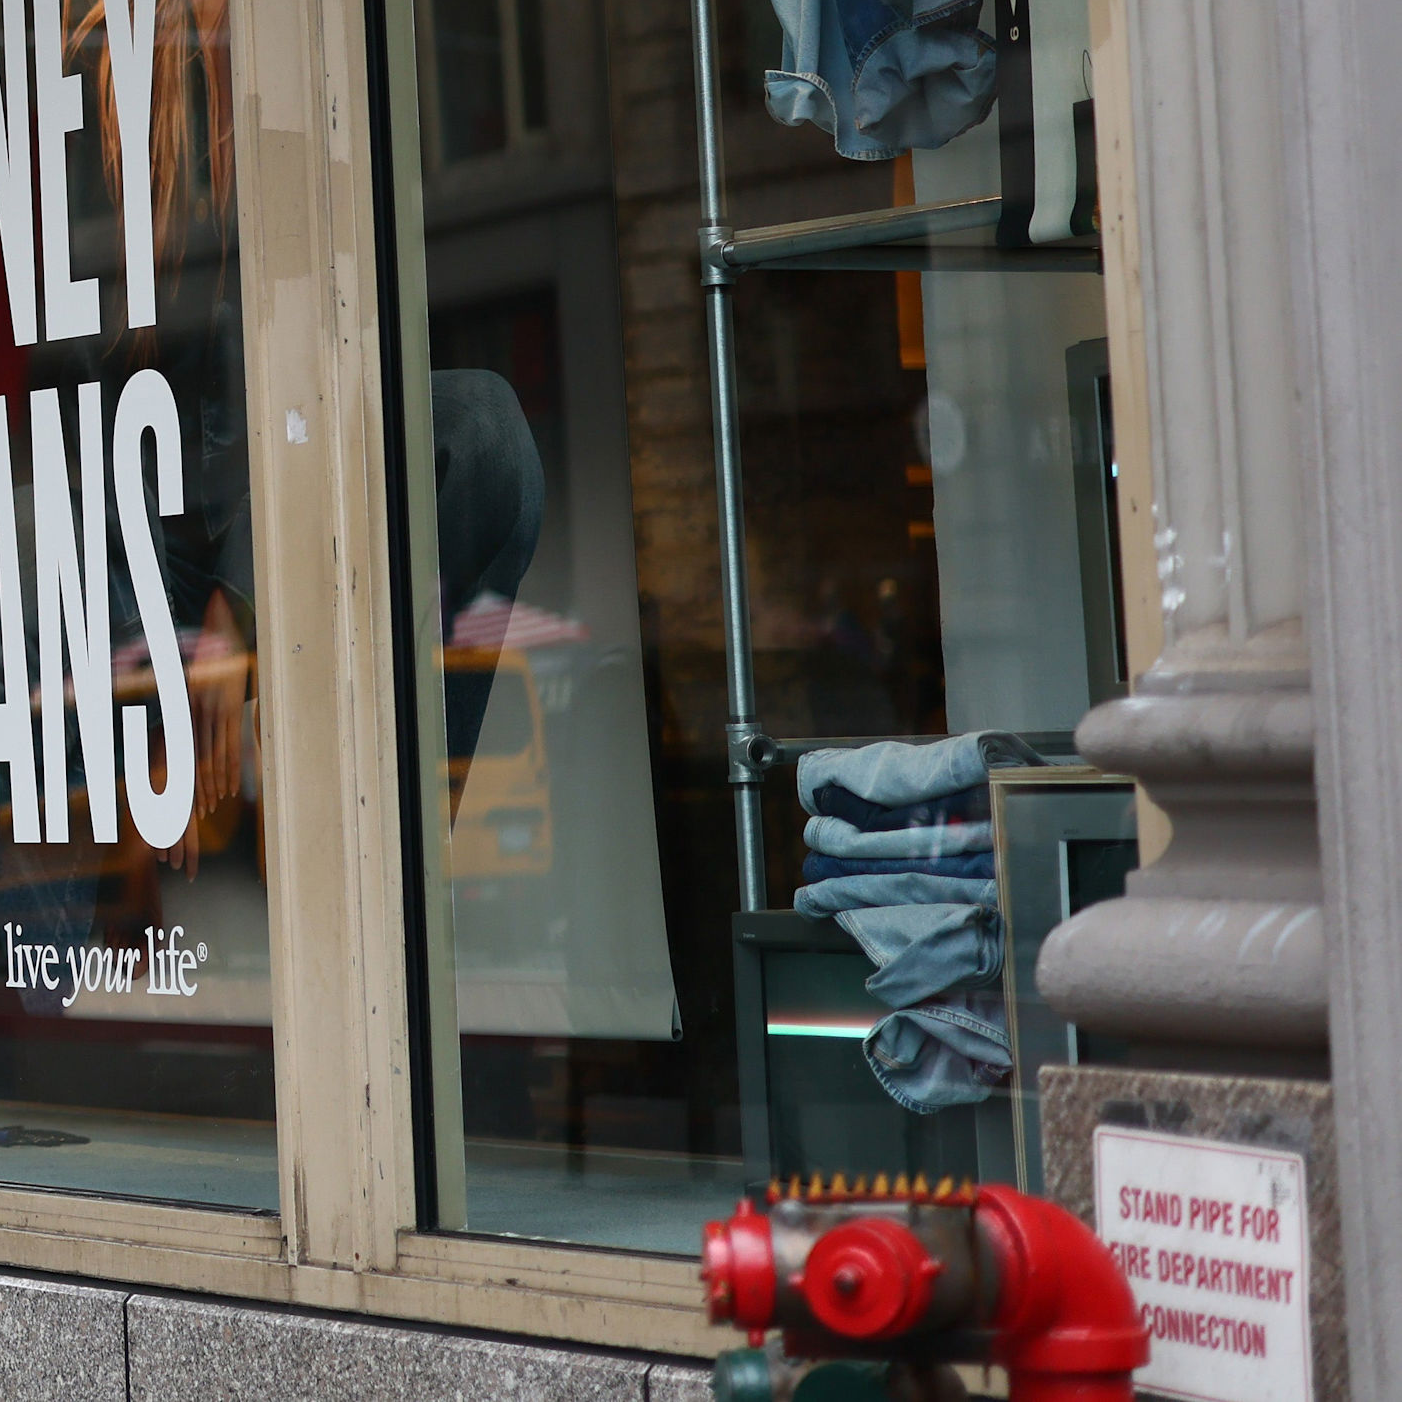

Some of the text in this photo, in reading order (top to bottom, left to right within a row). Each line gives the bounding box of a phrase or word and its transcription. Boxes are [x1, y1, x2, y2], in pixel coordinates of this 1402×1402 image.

[3, 921, 60, 991] live
[60, 946, 143, 1008] your
[1119, 1185, 1281, 1243] STAND PIPE FOR
[1110, 1241, 1294, 1306] FIRE DEPARTMENT
[1141, 1303, 1267, 1359] CONNECTION
